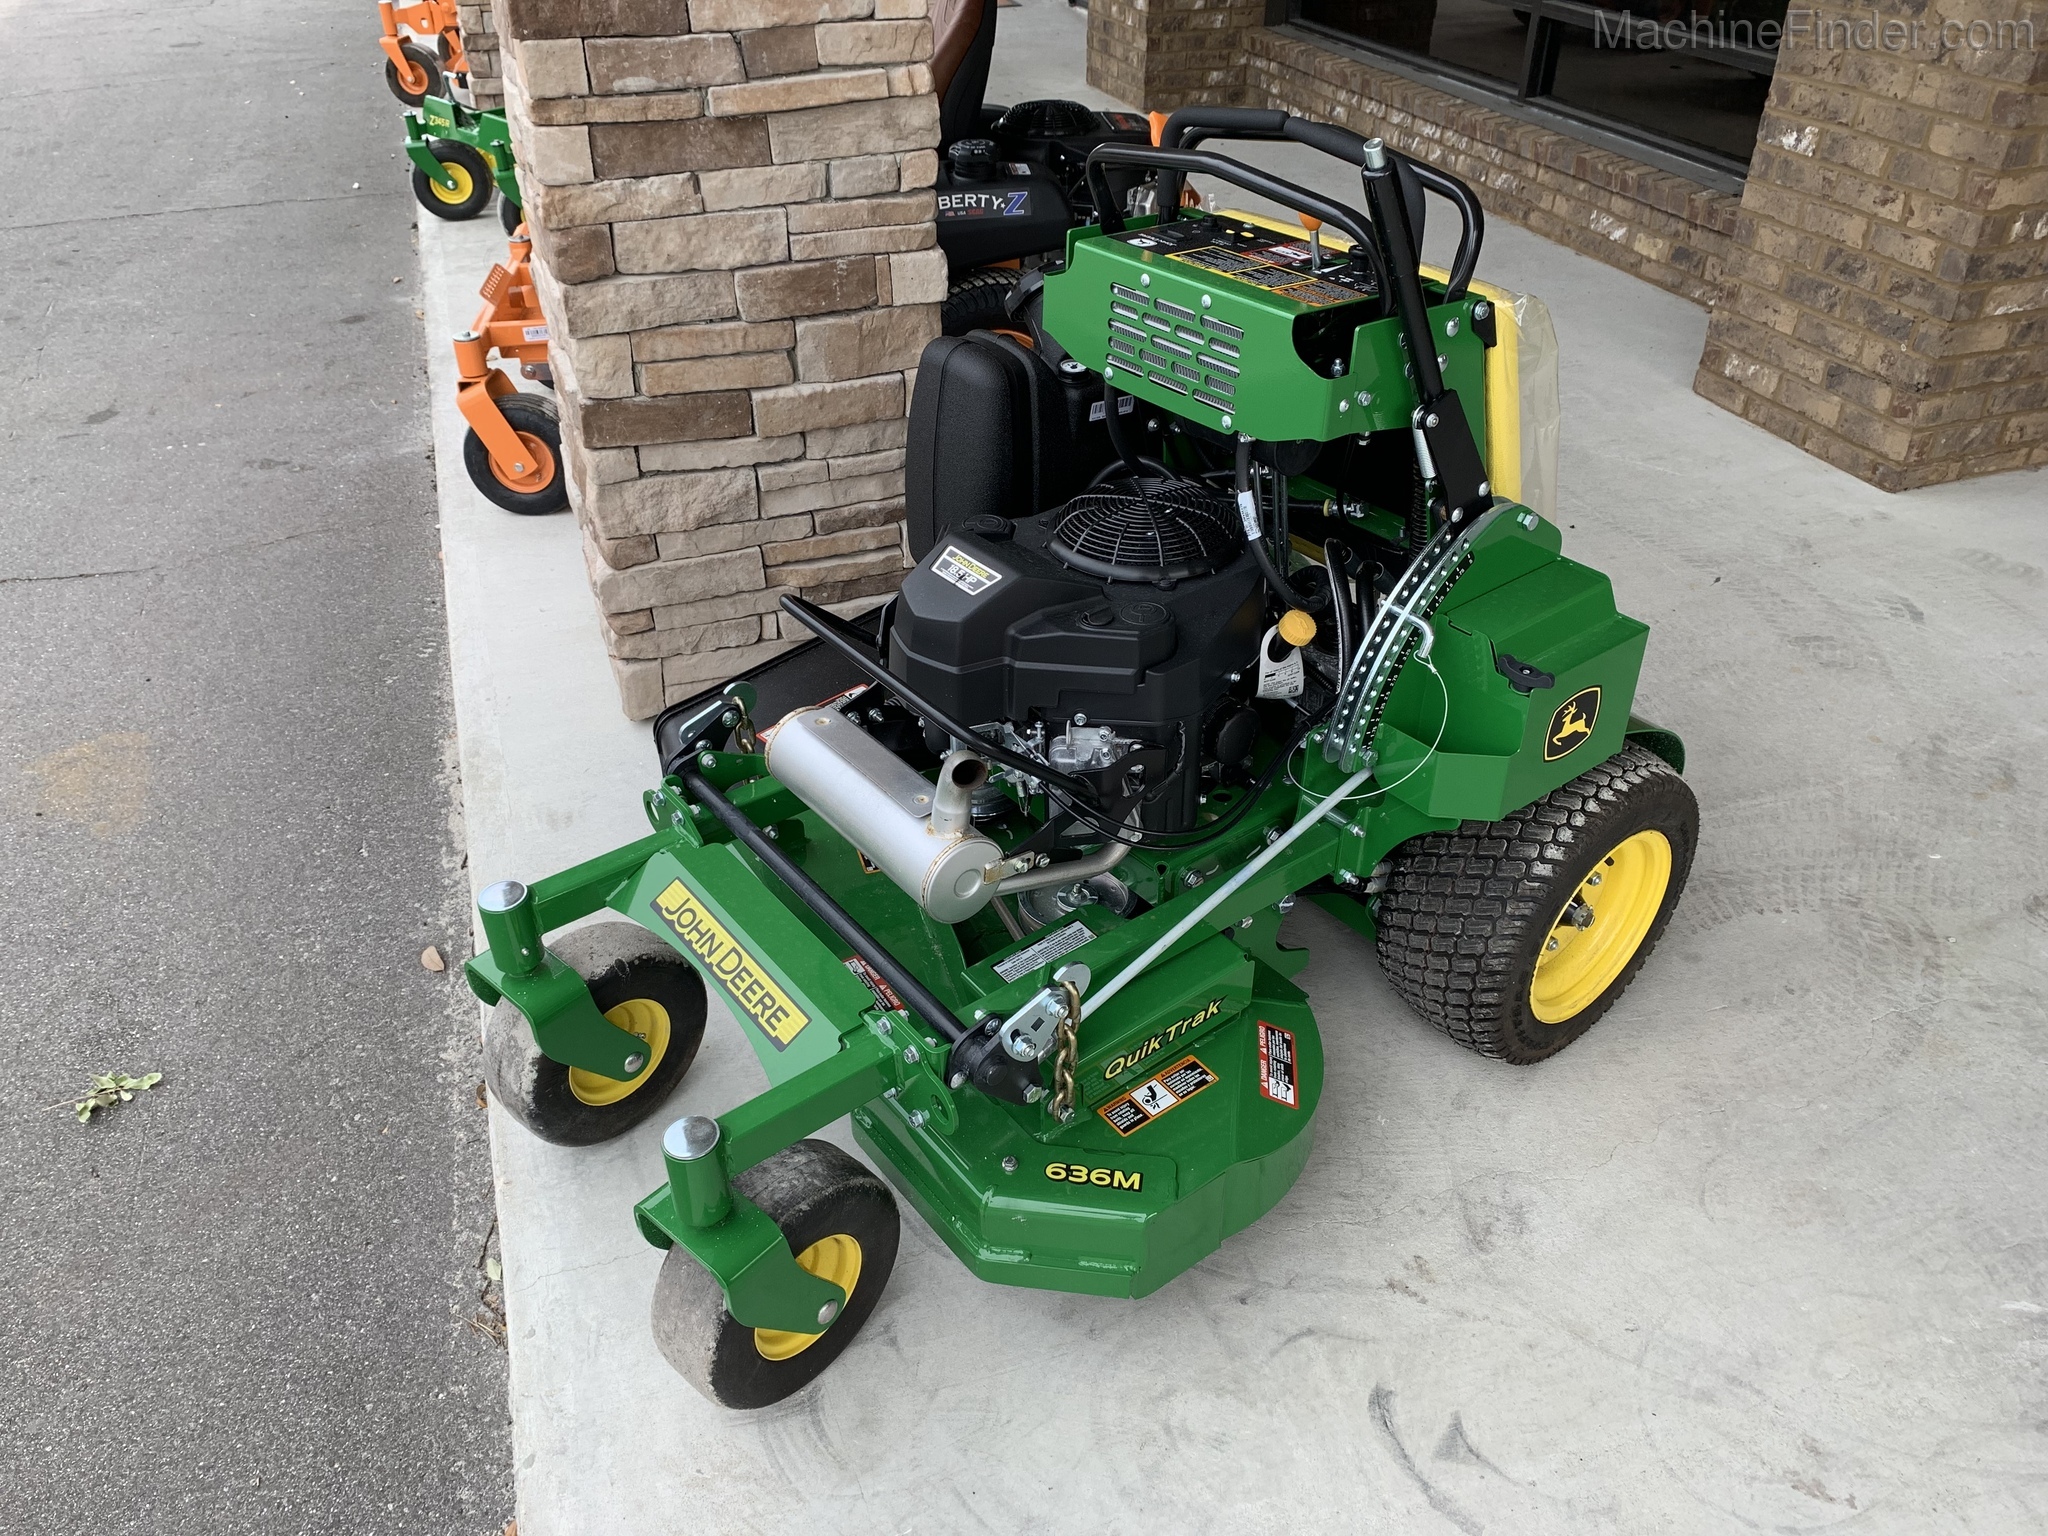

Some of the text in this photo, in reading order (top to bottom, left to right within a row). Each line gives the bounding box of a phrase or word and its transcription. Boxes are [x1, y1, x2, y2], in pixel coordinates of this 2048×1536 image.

[952, 554, 971, 569] JOHN
[969, 563, 990, 579] DEERE
[962, 573, 977, 584] HP
[664, 897, 791, 1033] JOHN DEERE
[1045, 1163, 1141, 1190] 636M
